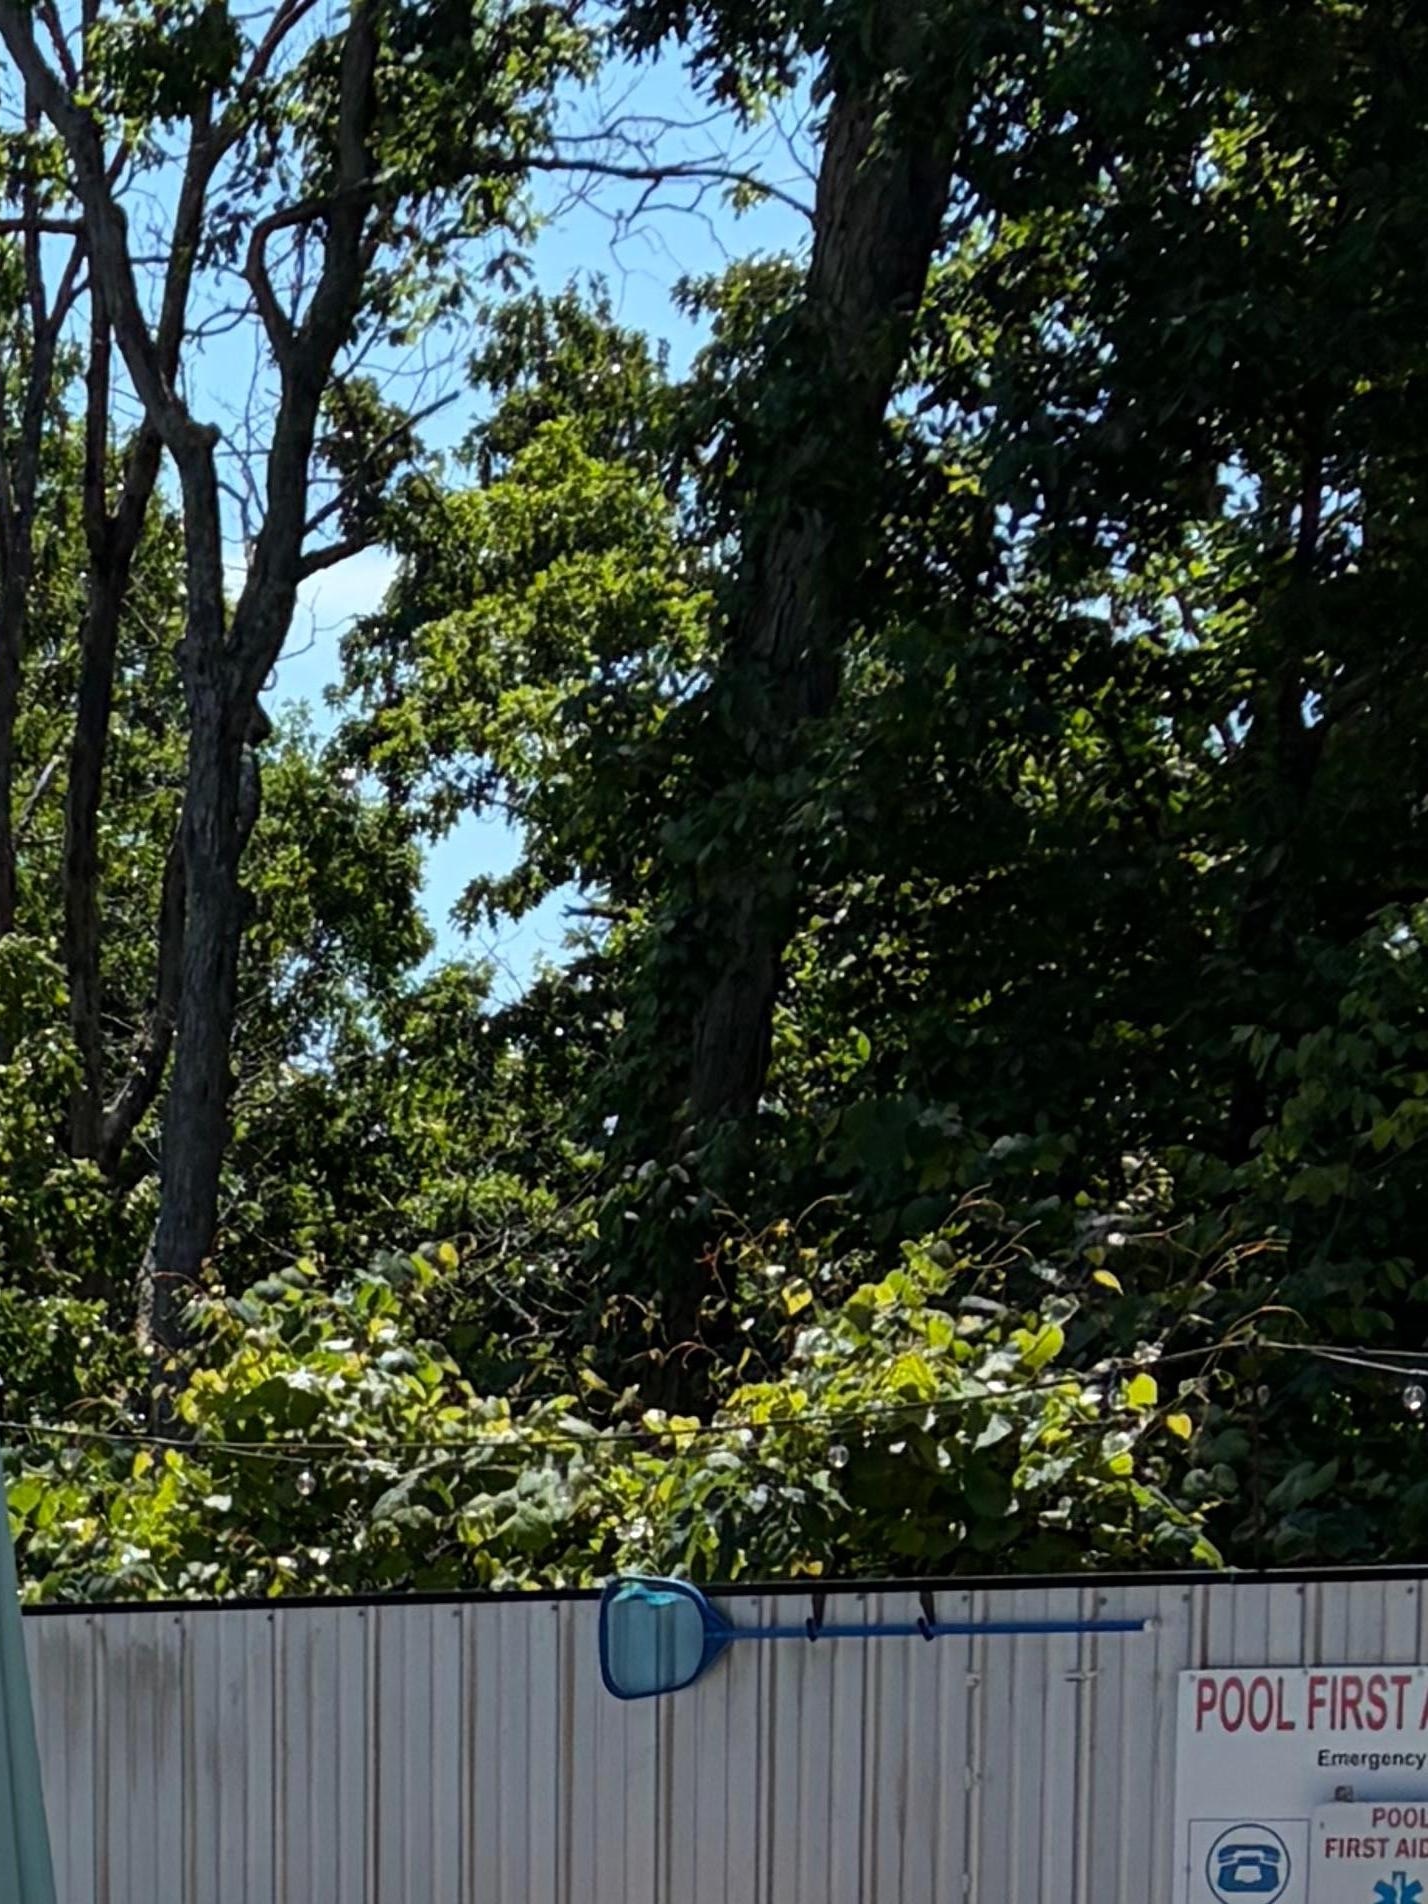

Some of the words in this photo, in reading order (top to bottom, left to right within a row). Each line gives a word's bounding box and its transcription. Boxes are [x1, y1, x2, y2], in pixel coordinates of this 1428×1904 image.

[1196, 1675, 1296, 1733] POOL
[1307, 1674, 1413, 1732] FIRST
[1317, 1749, 1427, 1771] Emergency
[1371, 1807, 1428, 1829] POOL
[1325, 1837, 1390, 1859] FIRST
